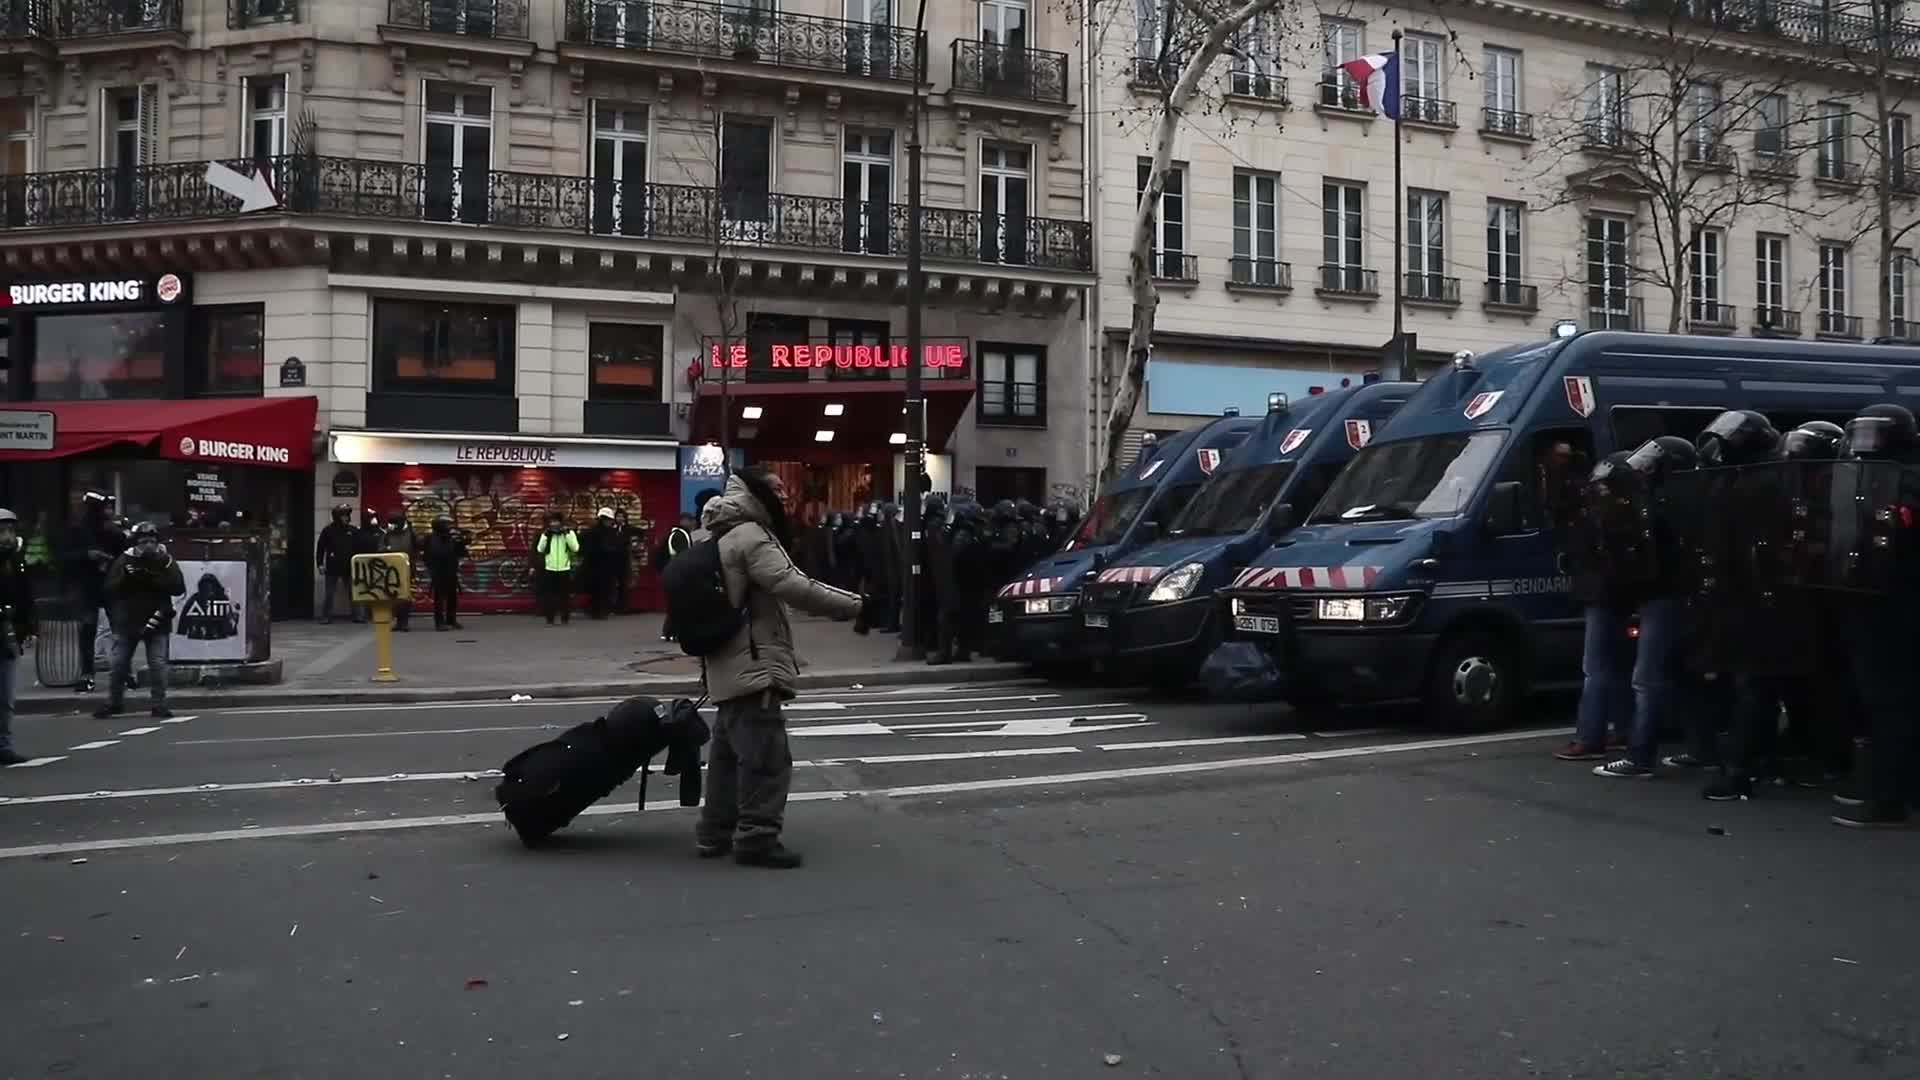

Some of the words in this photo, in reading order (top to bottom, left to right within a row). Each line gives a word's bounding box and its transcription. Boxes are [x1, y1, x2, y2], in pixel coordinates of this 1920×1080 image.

[9, 283, 86, 304] BURGER
[89, 279, 140, 301] KING
[712, 344, 747, 367] LE
[1360, 425, 1367, 434] 2
[199, 440, 255, 460] BURGER
[256, 445, 289, 463] KING
[456, 447, 474, 460] LE
